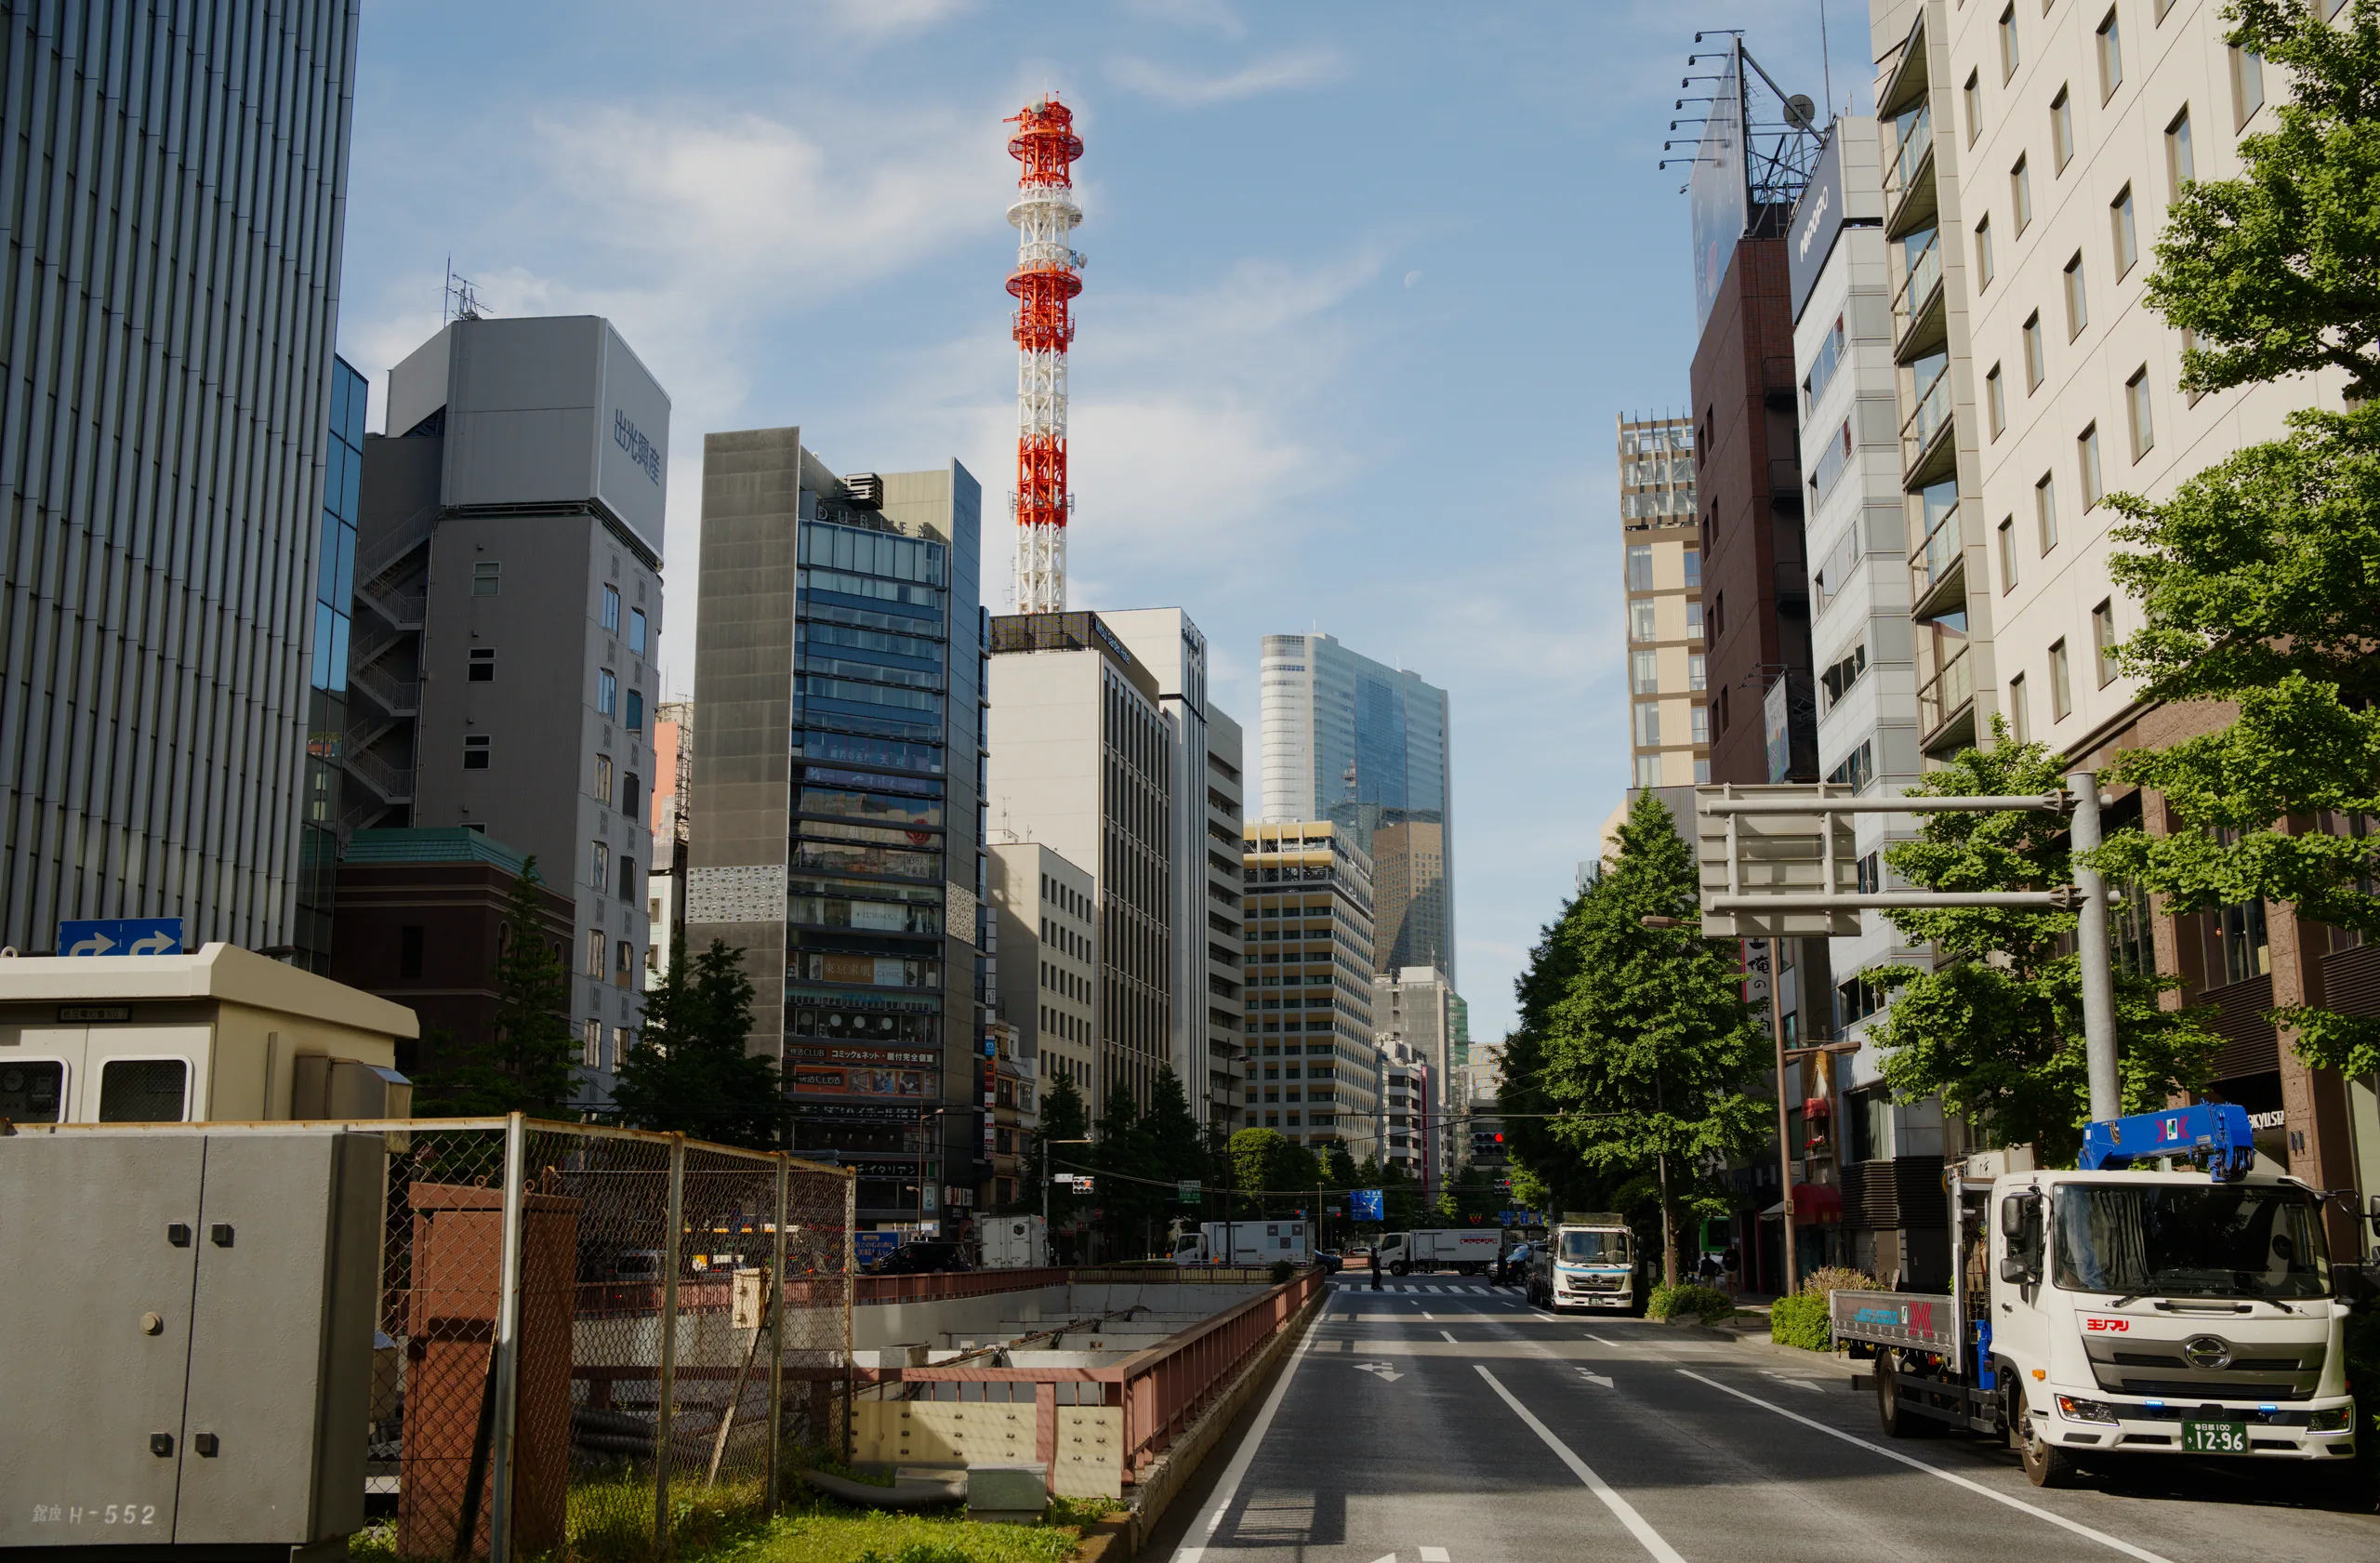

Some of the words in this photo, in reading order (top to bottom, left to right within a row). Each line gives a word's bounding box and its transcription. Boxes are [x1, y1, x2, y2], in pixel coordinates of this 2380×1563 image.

[615, 408, 660, 487] 出光興産
[817, 505, 928, 539] DURLEX
[825, 961, 871, 978] 東京素肌
[876, 969, 902, 980] CLINIC
[789, 1048, 825, 1058] 快活CLUB
[2215, 1424, 2231, 1432] 100
[2196, 1431, 2244, 1451] 12-96
[69, 1504, 157, 1526] H-552
